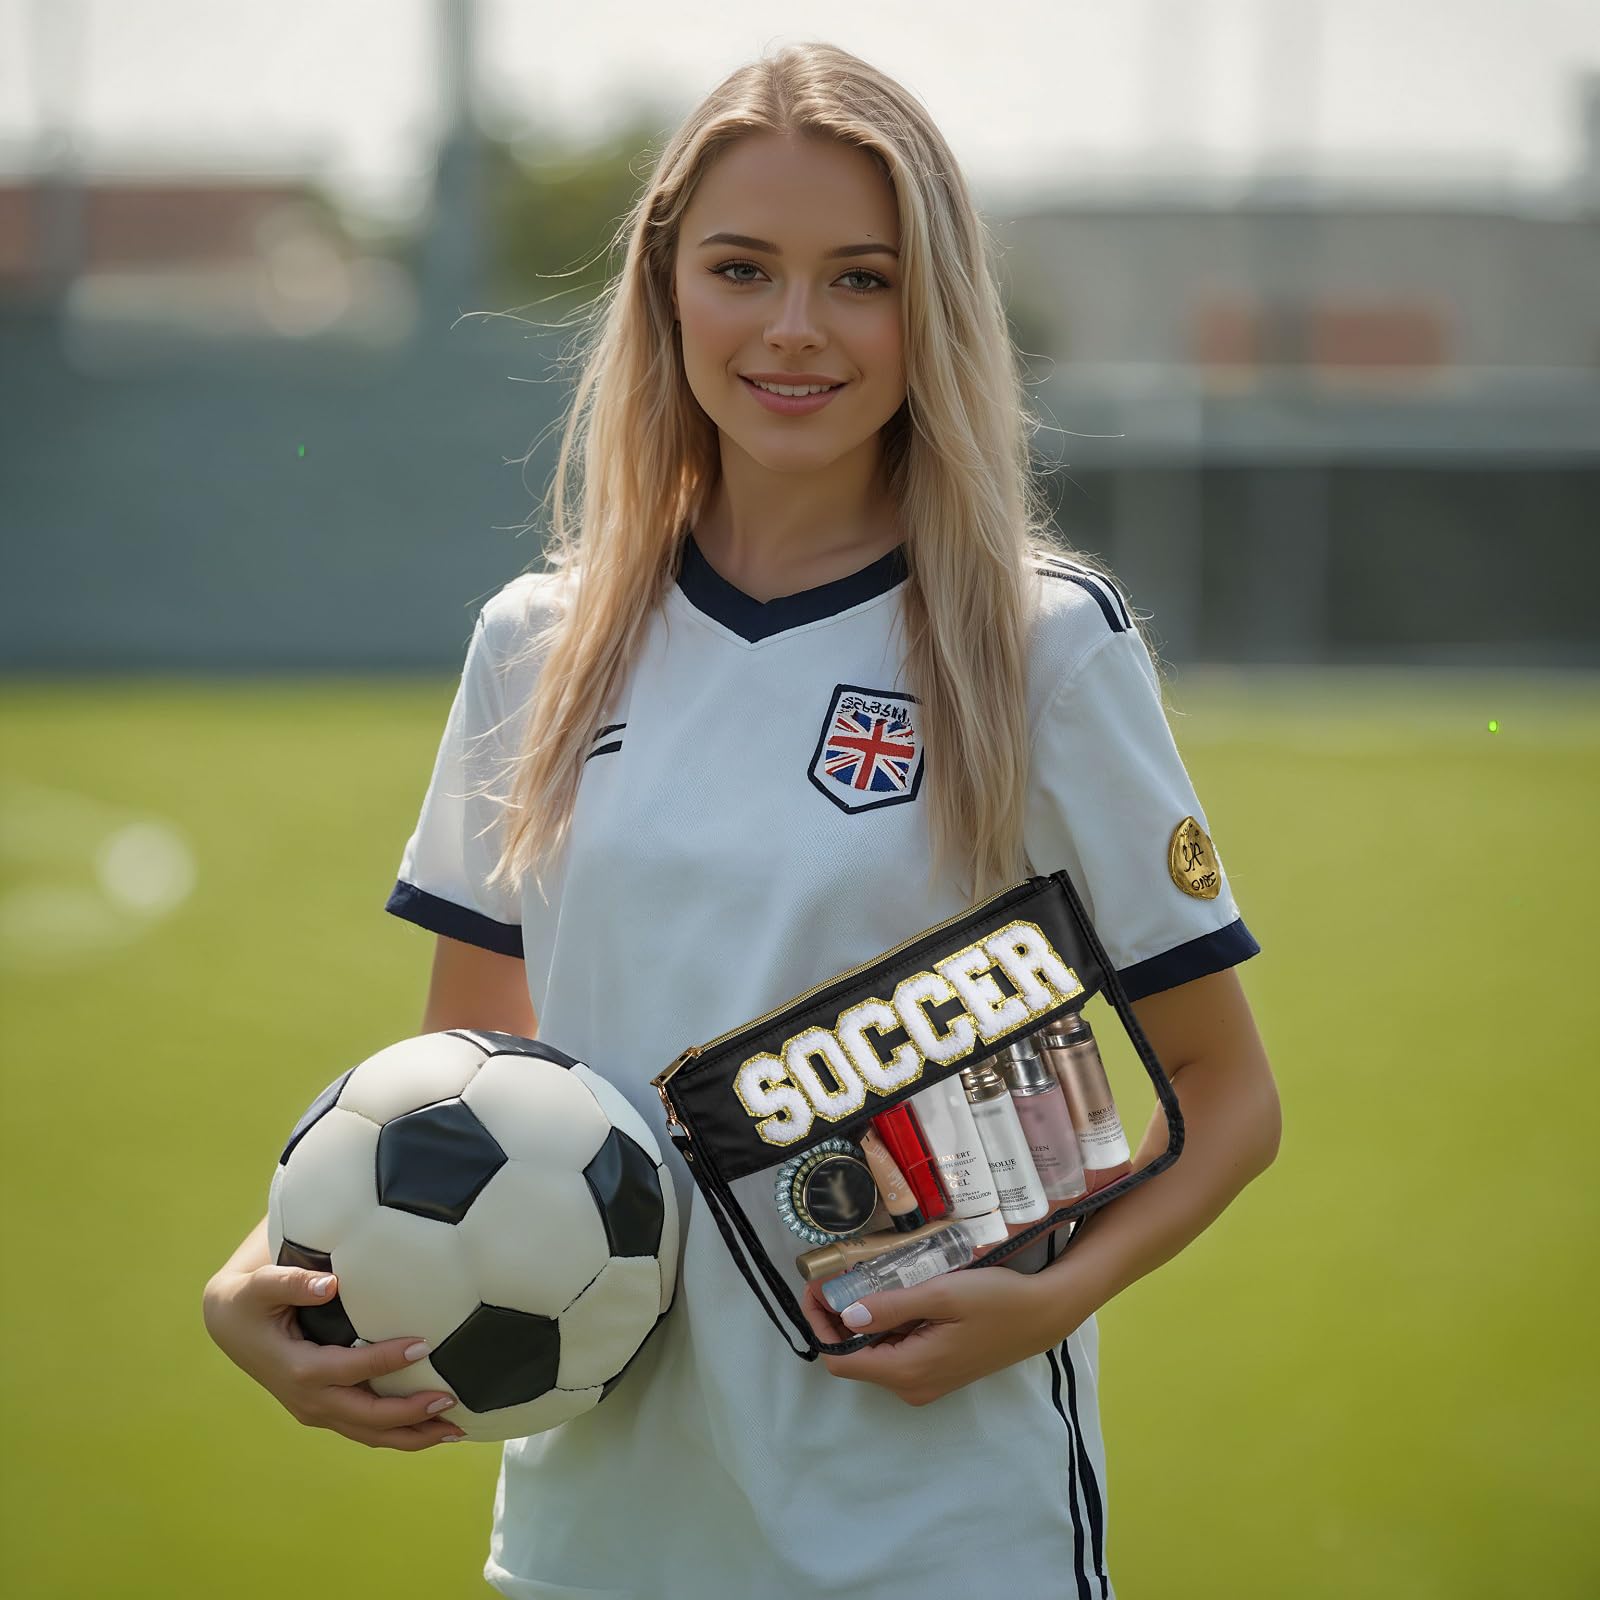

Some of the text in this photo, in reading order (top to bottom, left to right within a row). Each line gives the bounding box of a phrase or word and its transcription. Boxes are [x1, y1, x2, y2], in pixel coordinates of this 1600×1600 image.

[733, 920, 1084, 1147] SOCCER
[950, 1178, 970, 1189] GEL
[968, 1191, 992, 1201] POLLUTION
